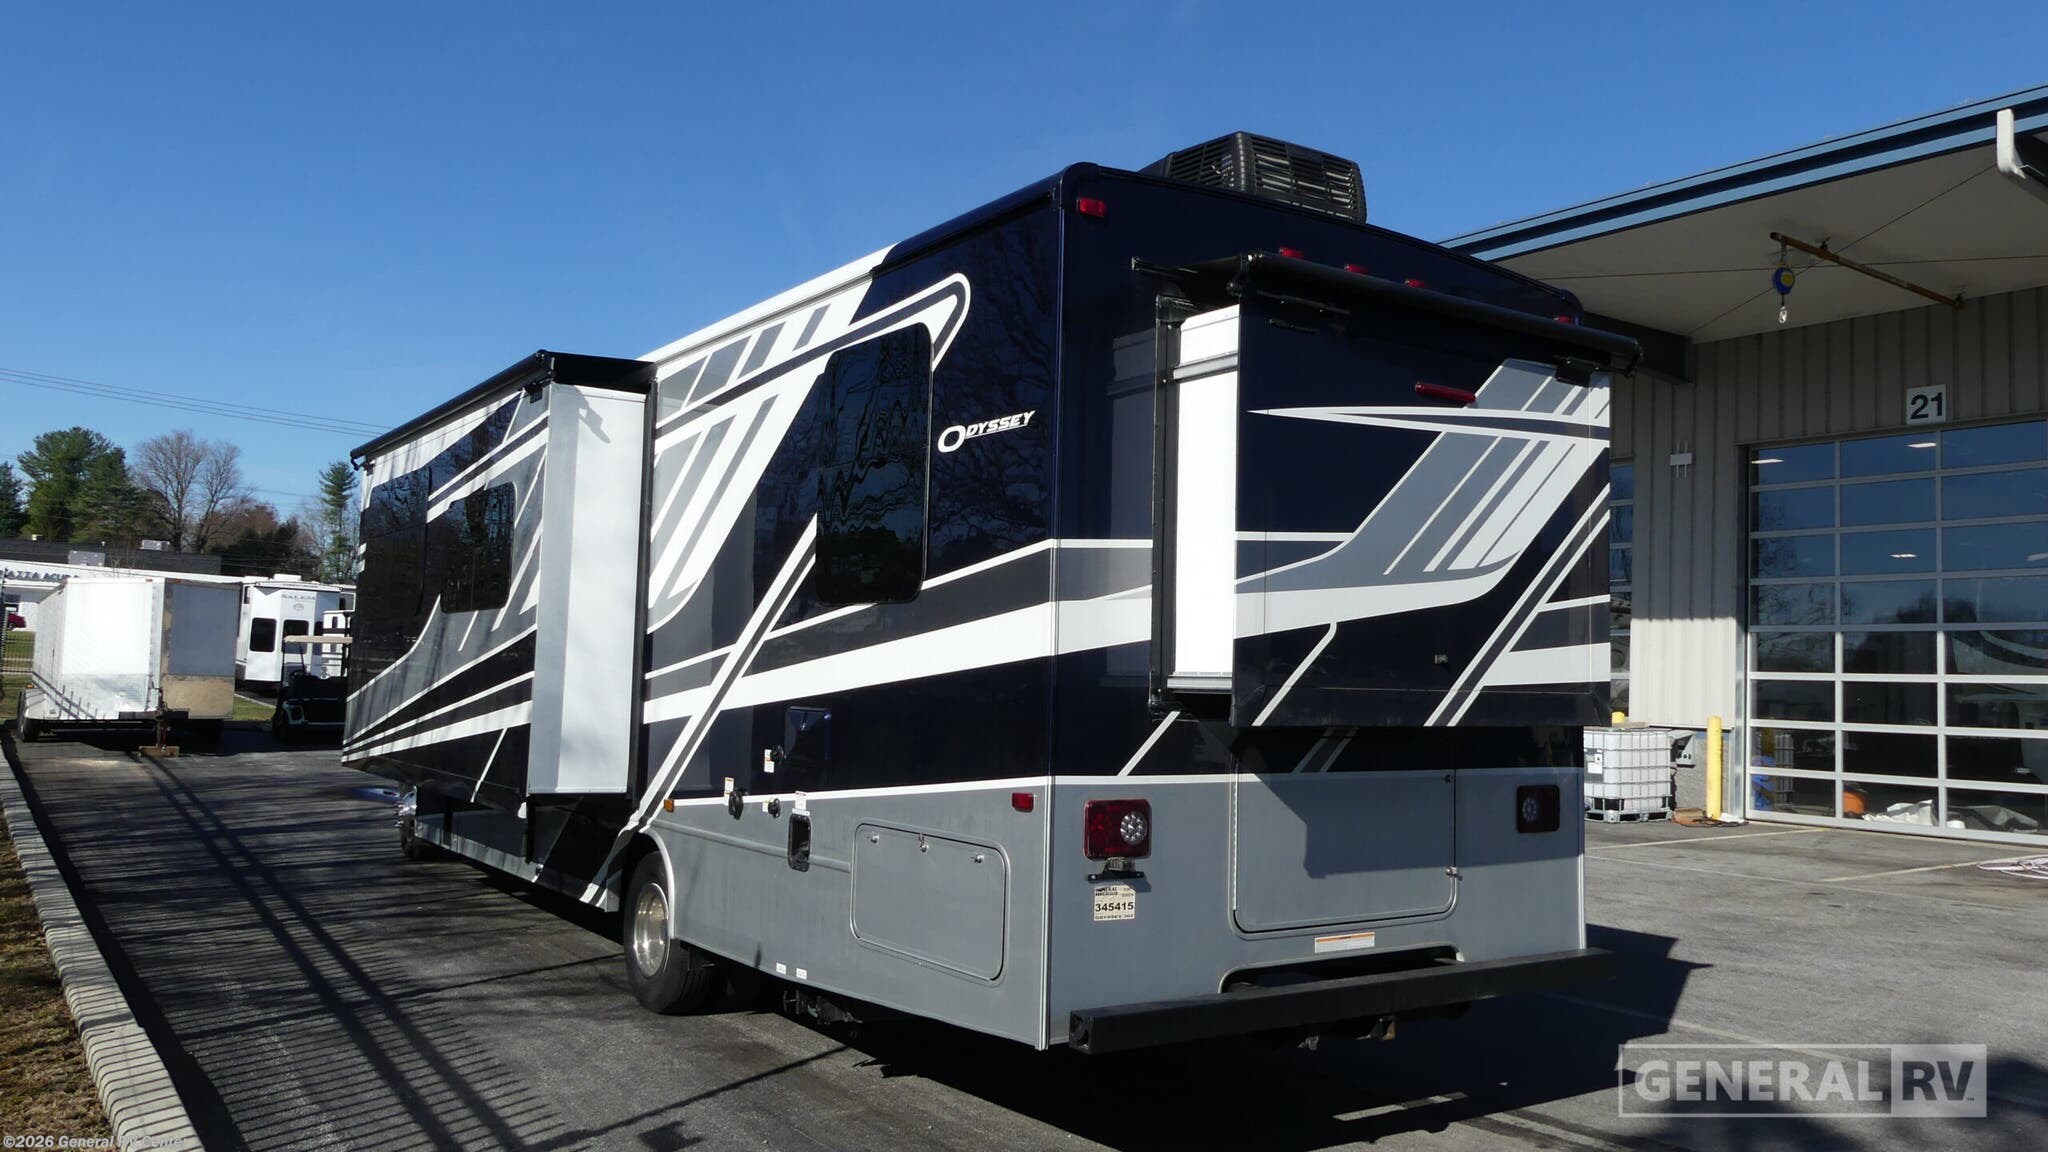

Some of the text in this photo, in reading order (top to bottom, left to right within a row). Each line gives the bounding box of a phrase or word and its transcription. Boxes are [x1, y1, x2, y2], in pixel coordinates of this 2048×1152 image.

[1910, 392, 1943, 420] 21
[938, 410, 1036, 453] ODYSSEY
[43, 572, 80, 582] ACU
[1095, 901, 1134, 912] 345415
